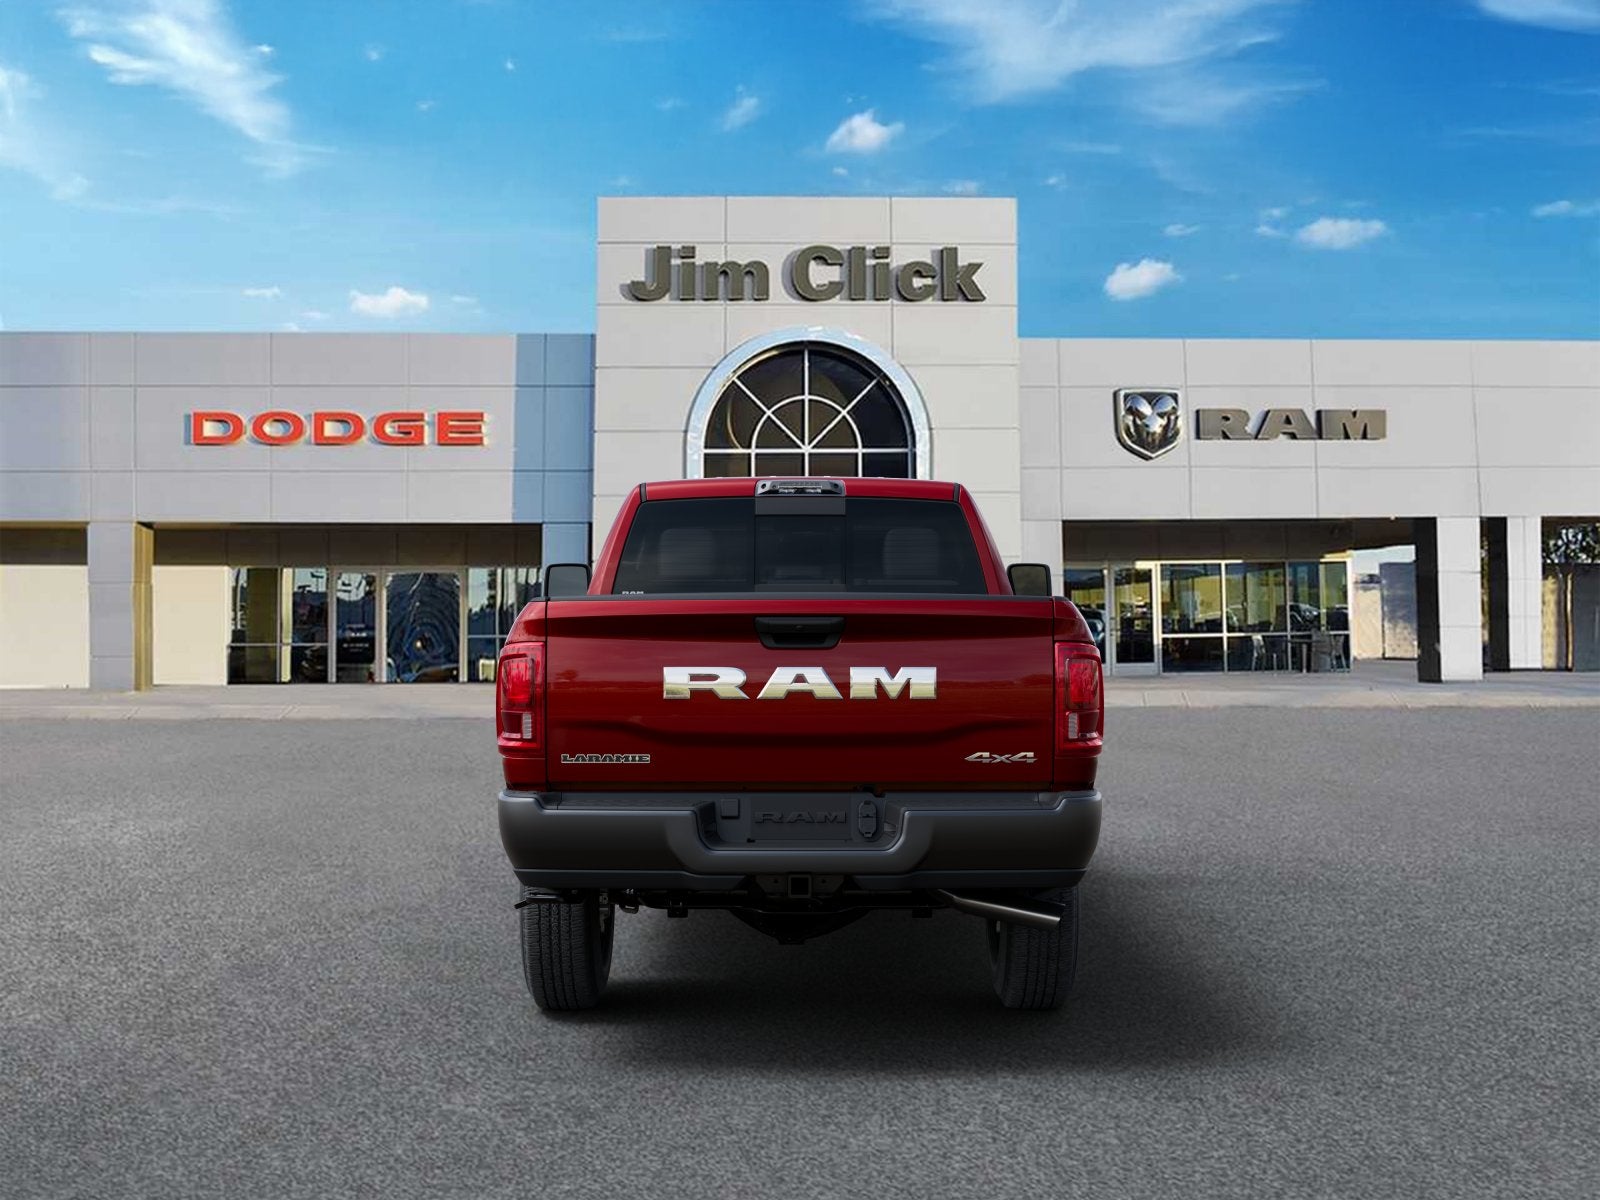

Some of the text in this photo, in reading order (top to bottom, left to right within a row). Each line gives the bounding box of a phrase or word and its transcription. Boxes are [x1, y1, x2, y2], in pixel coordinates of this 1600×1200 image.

[624, 245, 986, 301] Jim Click
[190, 410, 487, 447] DODGE
[1196, 408, 1387, 440] RAM
[663, 666, 937, 700] RAM
[561, 753, 651, 764] LARAMIE
[964, 751, 1038, 764] 4x4
[754, 811, 847, 824] RAM
